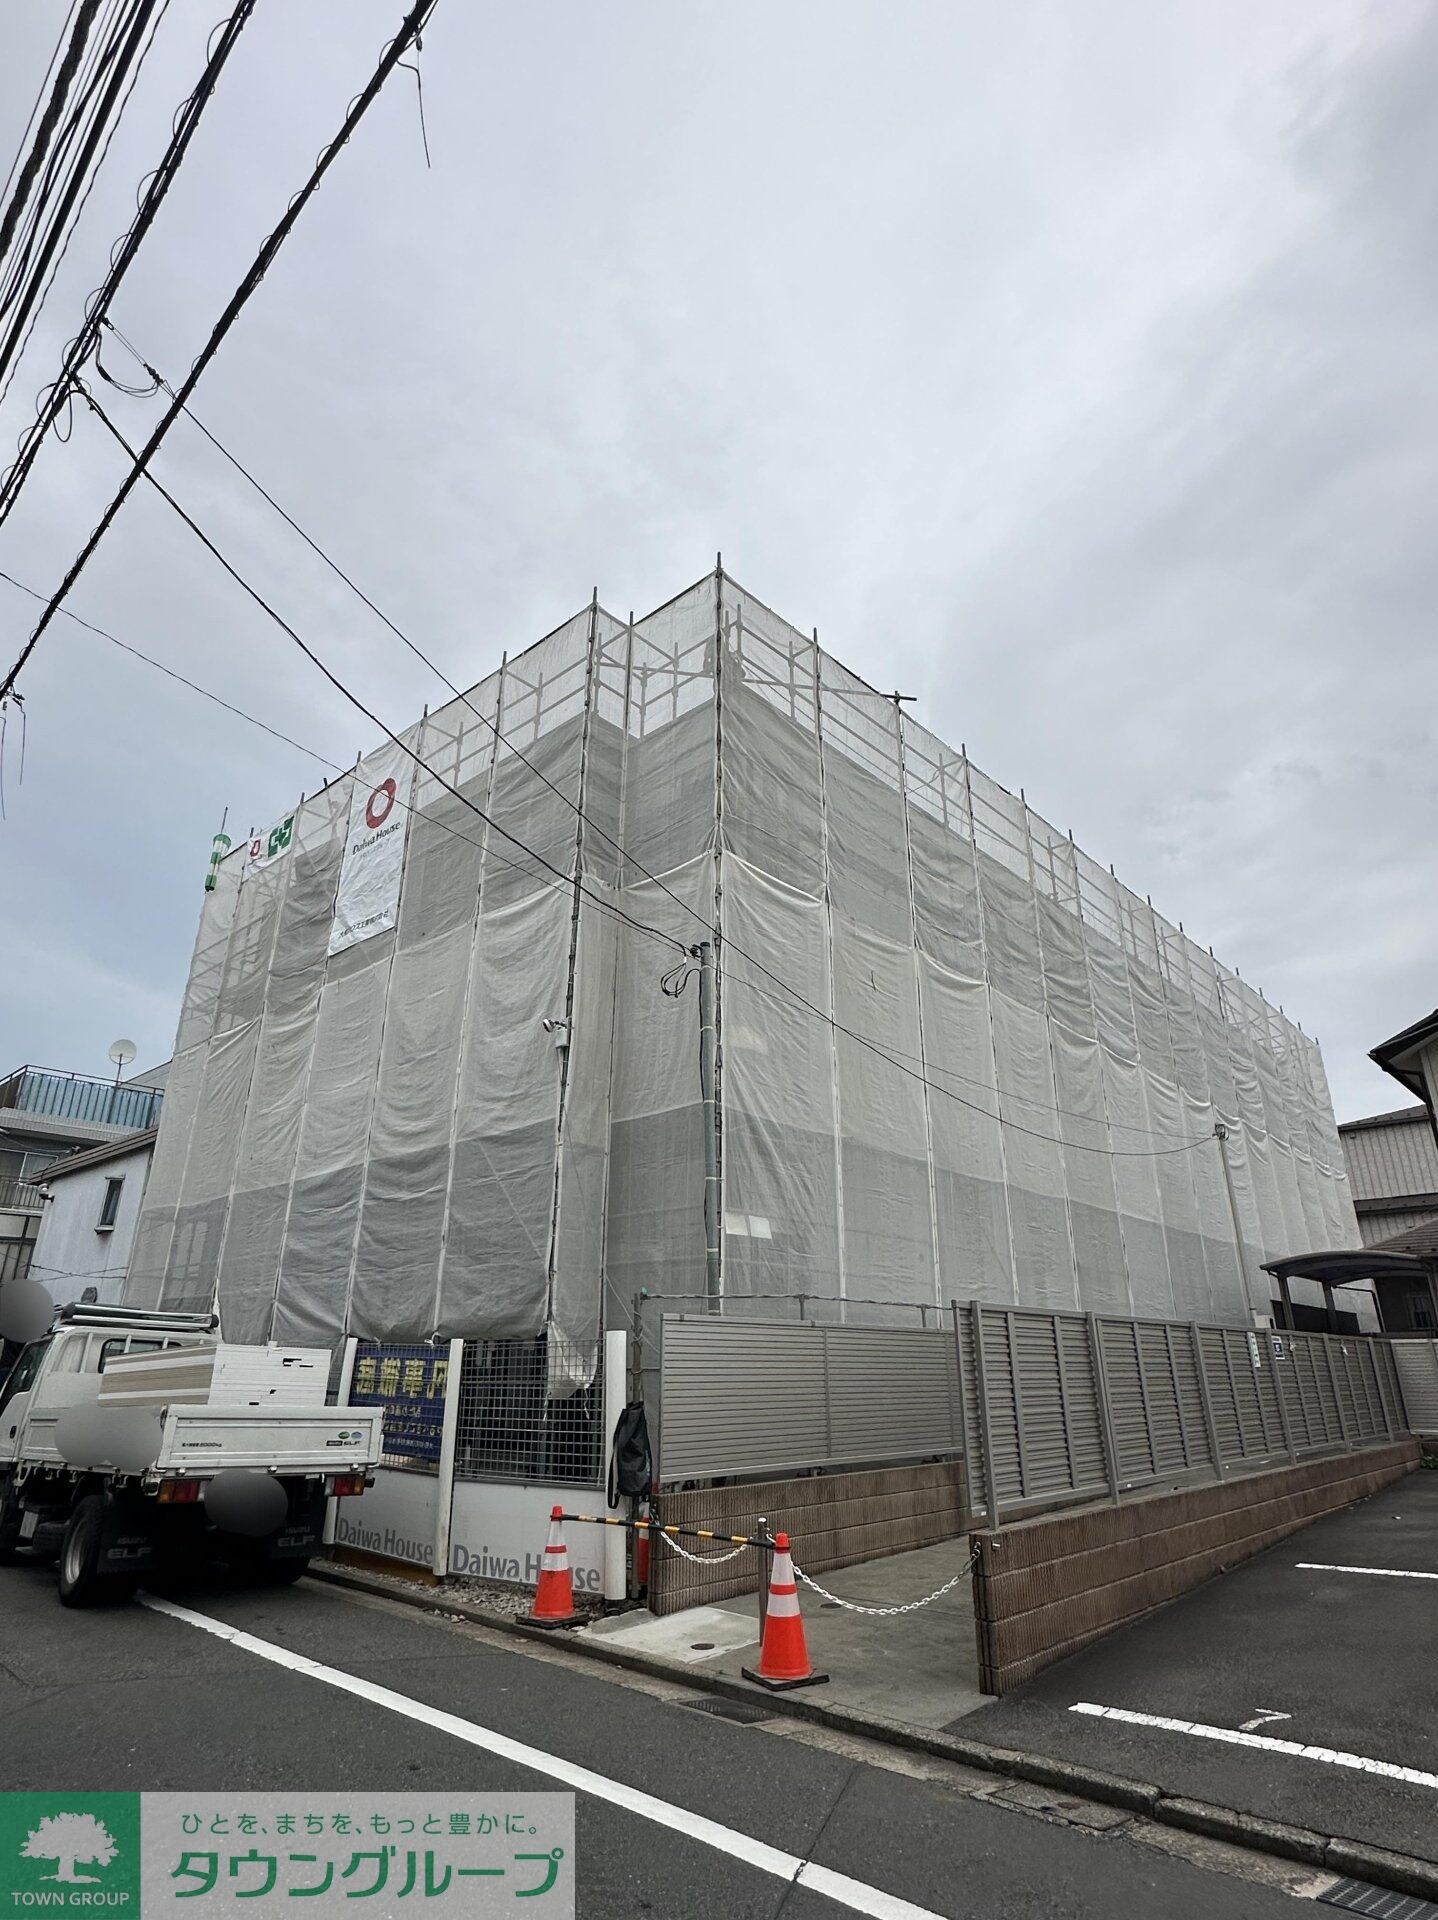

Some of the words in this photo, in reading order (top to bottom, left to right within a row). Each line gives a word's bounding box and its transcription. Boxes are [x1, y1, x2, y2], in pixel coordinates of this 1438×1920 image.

[277, 1535, 316, 1547] ELF
[338, 1518, 381, 1552] Daiwa
[384, 1529, 433, 1564] House
[107, 1547, 153, 1560] ELF
[453, 1544, 520, 1579] Daiwa
